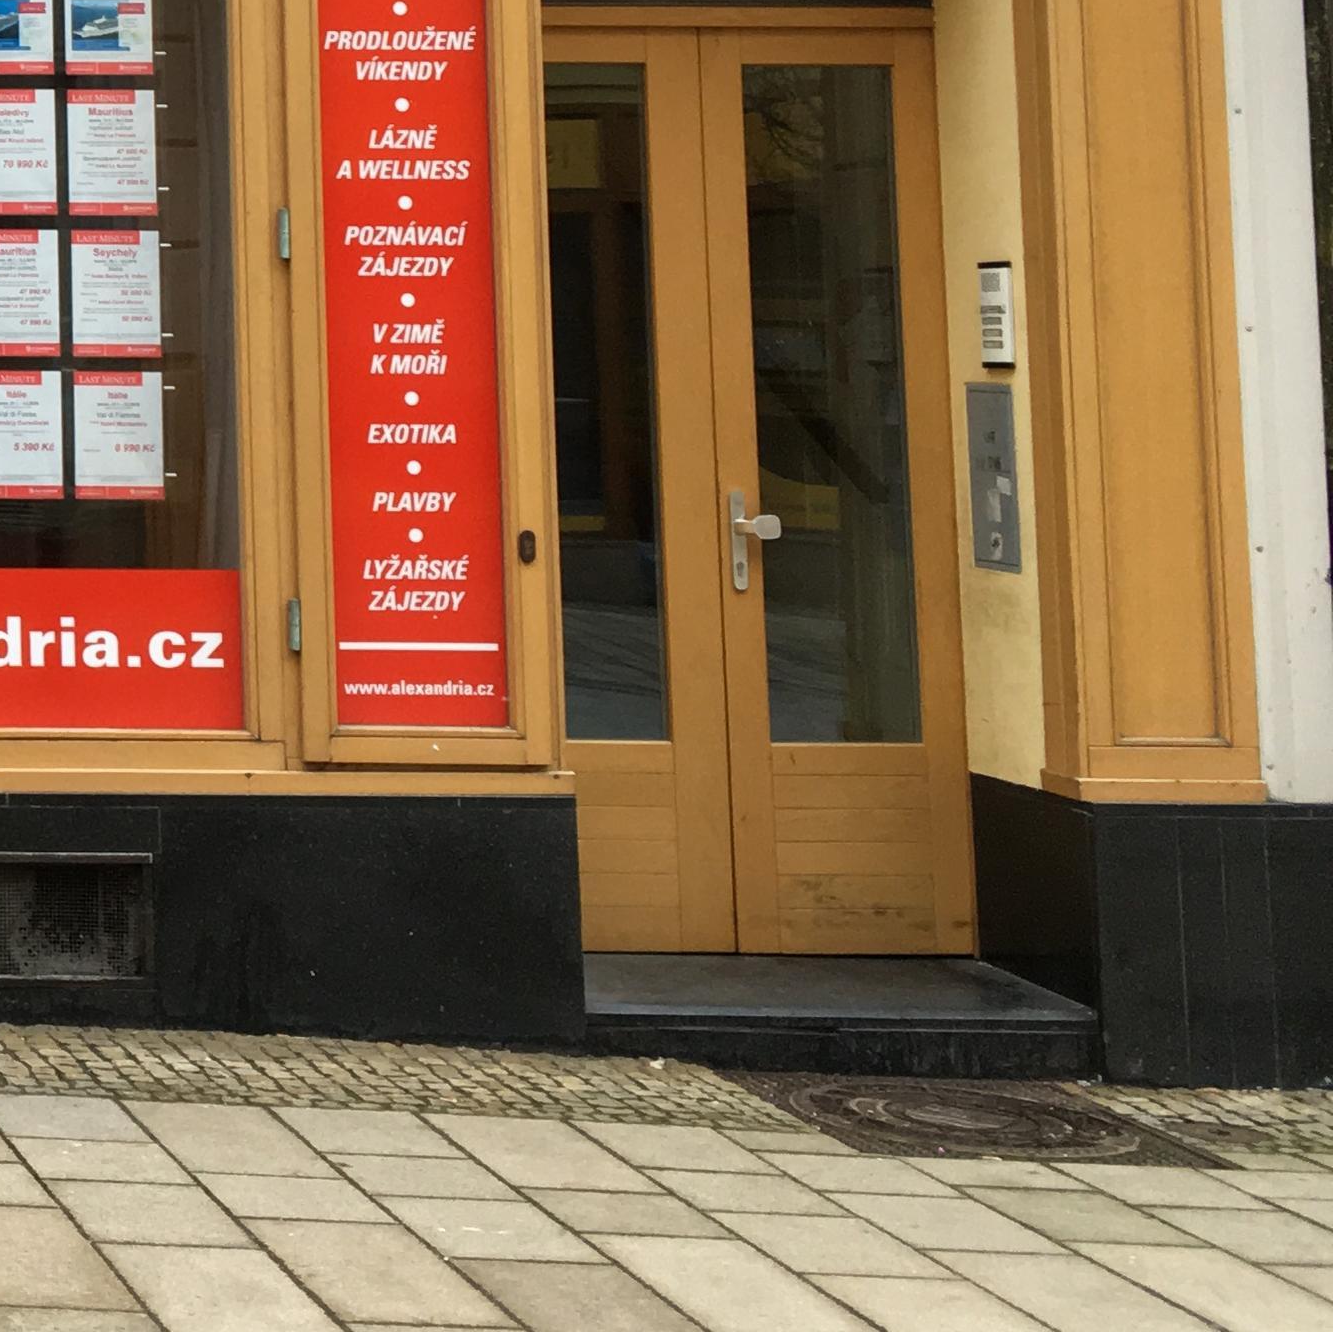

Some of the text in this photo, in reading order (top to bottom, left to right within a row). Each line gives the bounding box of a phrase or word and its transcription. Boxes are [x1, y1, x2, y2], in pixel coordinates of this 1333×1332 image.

[324, 26, 476, 50] PRODLOUŽENÉ
[356, 56, 447, 80] VÍKENDY
[89, 108, 133, 116] Mauritius
[369, 125, 437, 149] LÁZNĚ
[337, 160, 470, 179] A WELLNESS
[345, 221, 467, 245] POZNÁVACÍ
[358, 252, 453, 276] ZÁJEZDY
[374, 319, 444, 343] V ZIMĚ
[371, 350, 447, 374] K MOŘI
[368, 424, 456, 444] EXOTIKA
[373, 492, 456, 511] PLAVBY
[364, 555, 469, 580] LYŽAŘSKÉ
[369, 586, 465, 611] ZÁJEZDY
[345, 680, 494, 695] www.alexandria.cz
